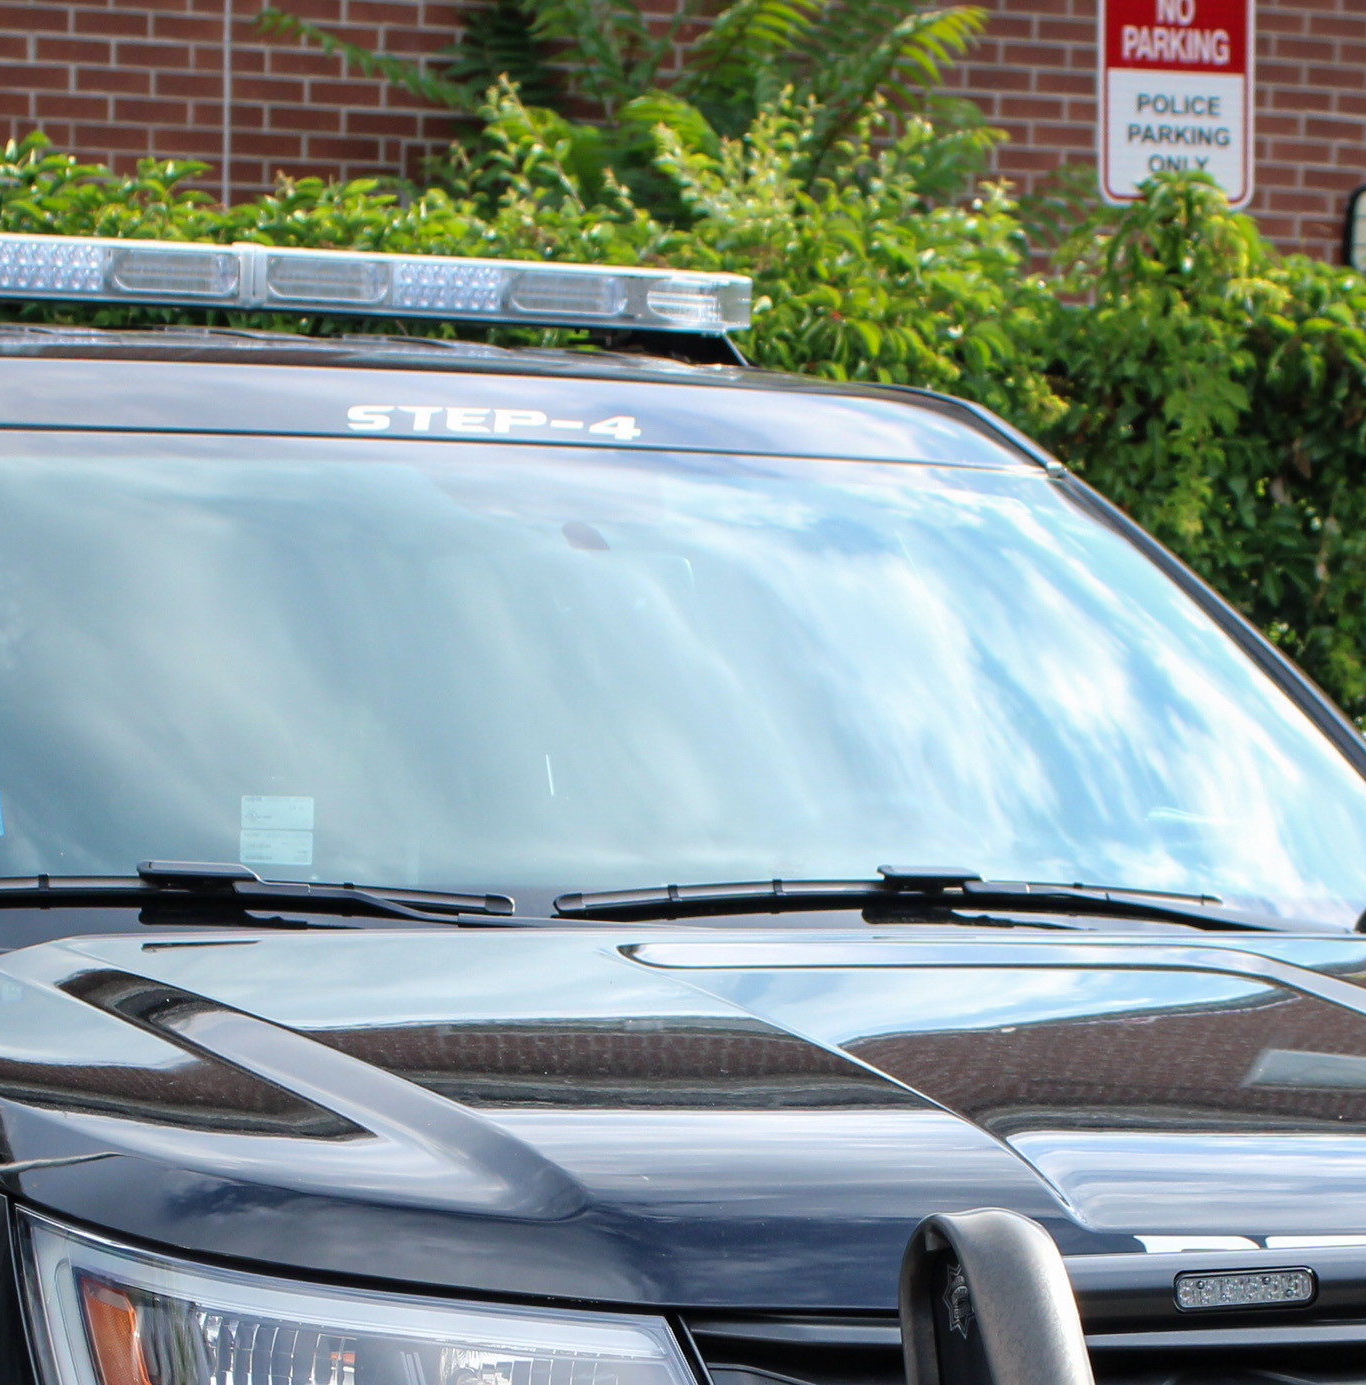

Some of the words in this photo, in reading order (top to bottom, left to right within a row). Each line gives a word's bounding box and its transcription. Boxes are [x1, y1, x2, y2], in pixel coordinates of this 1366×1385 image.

[1156, 0, 1196, 26] NO
[1122, 26, 1231, 65] PARKING
[1137, 93, 1221, 116] POLICE
[1127, 124, 1231, 147] PARKING
[347, 404, 641, 441] STEP-4
